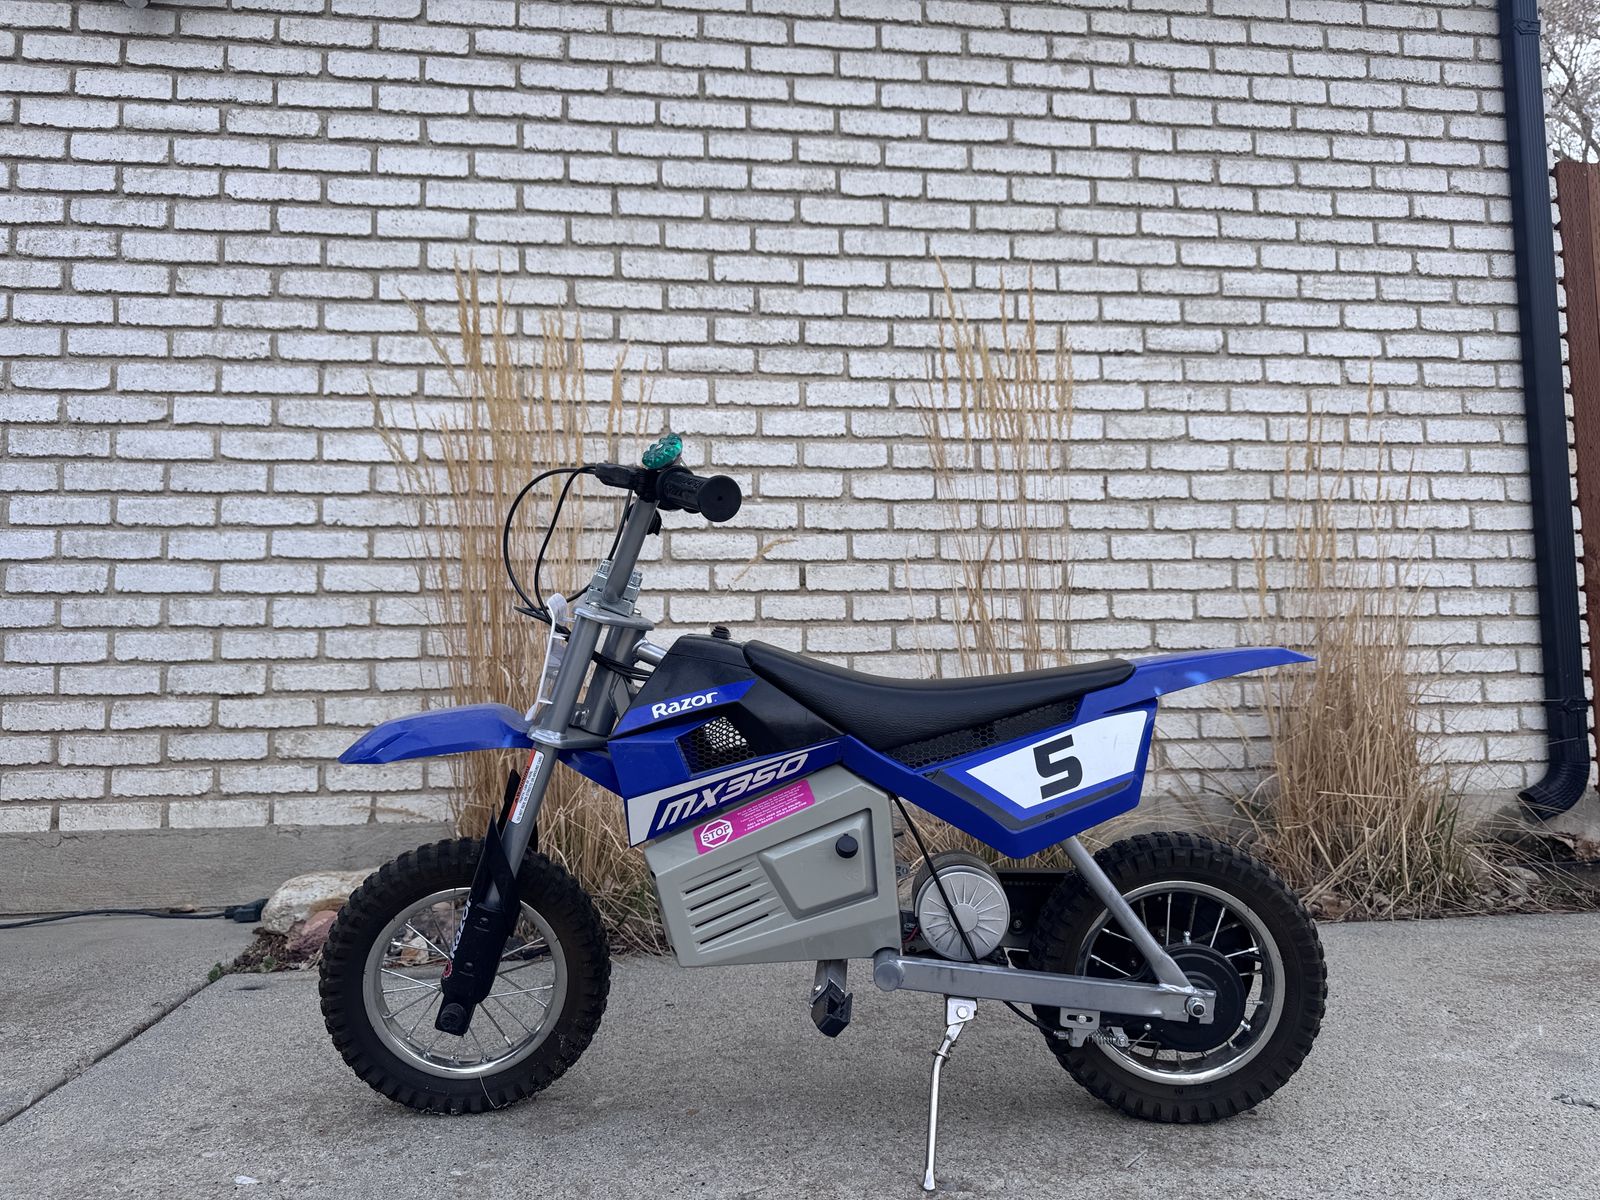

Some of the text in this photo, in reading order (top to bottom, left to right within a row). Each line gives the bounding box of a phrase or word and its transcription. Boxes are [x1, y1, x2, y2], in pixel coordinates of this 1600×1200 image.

[651, 691, 718, 719] Razor
[1032, 734, 1083, 799] 5
[656, 753, 808, 831] MX350
[702, 824, 730, 843] STOP
